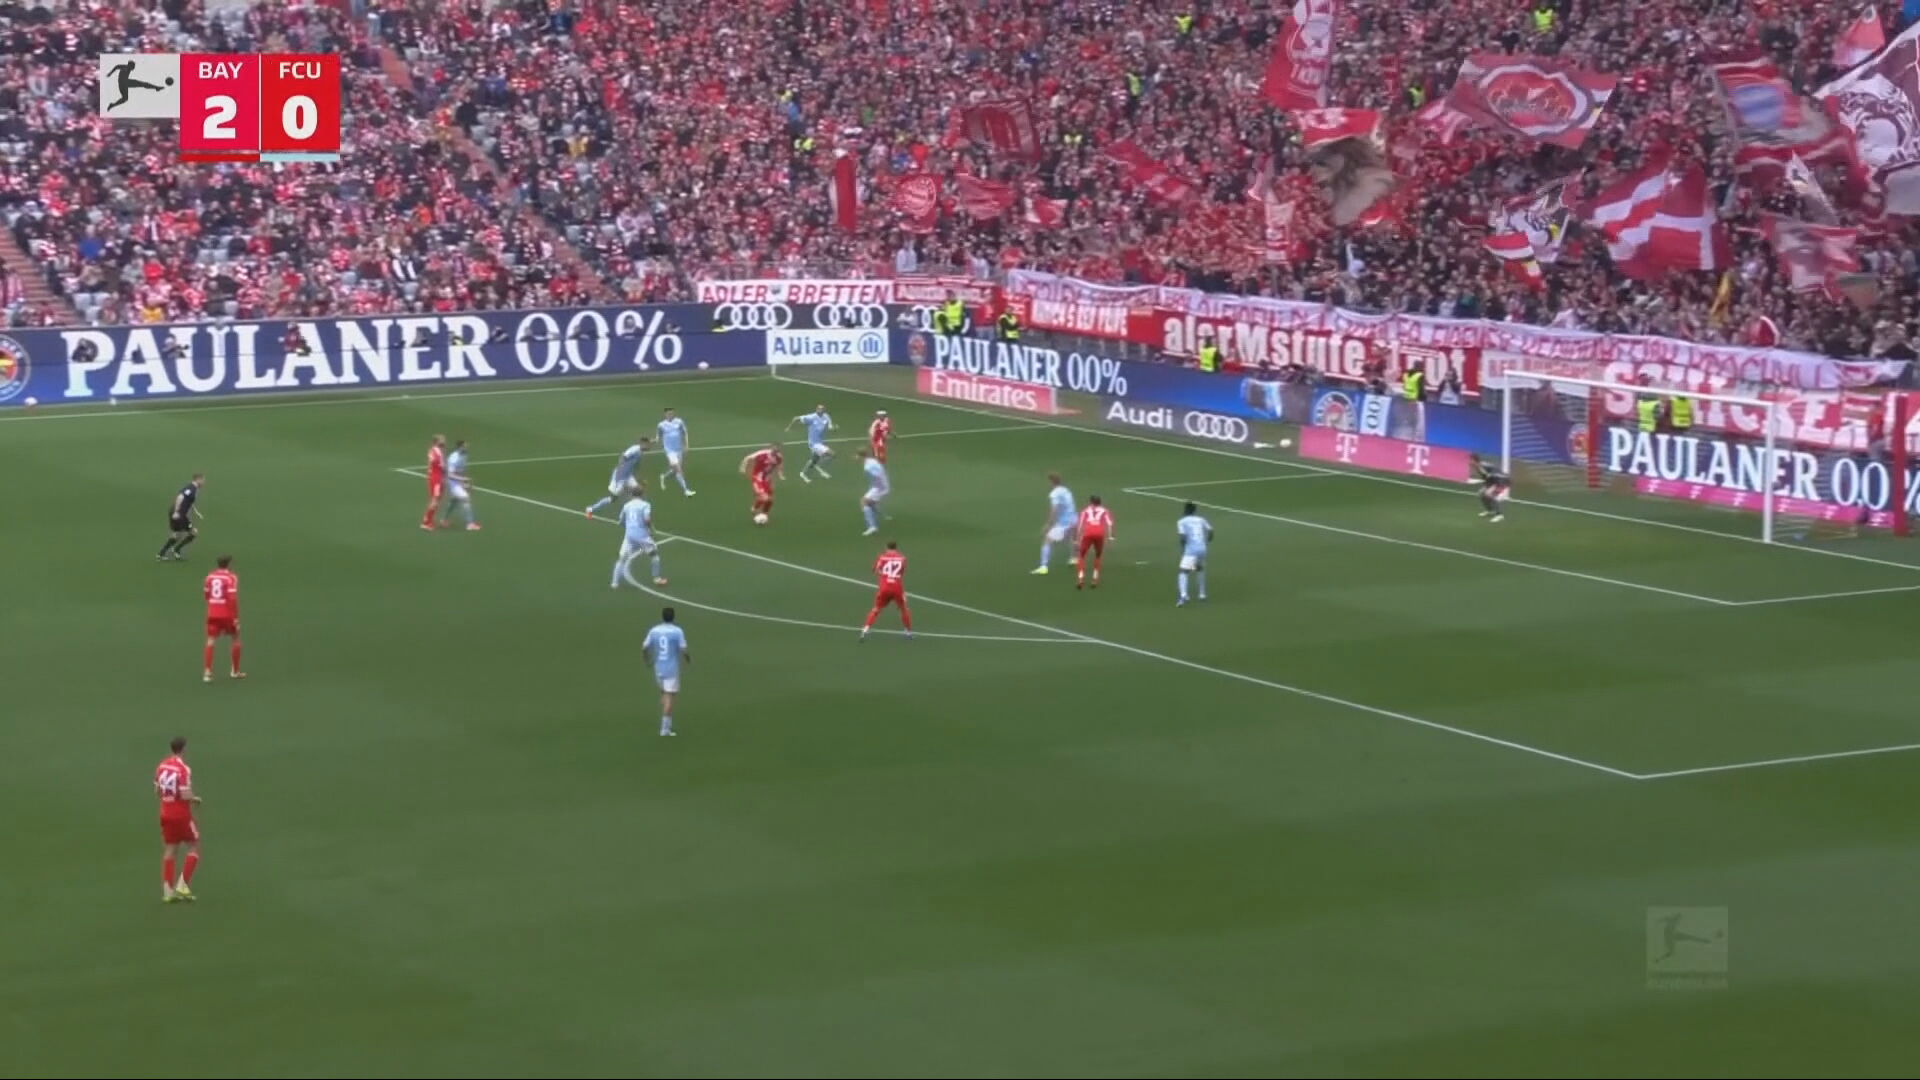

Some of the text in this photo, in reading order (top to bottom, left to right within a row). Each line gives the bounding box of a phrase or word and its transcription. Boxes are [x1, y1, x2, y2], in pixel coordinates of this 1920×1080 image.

[702, 285, 768, 303] ADLER
[788, 284, 889, 303] BRETTEN
[61, 315, 498, 398] PAULANER
[772, 336, 852, 357] Allianz
[933, 334, 1062, 388] PAULANER
[929, 371, 1038, 411] Emirates
[1106, 401, 1173, 430] Audi
[1608, 426, 1822, 501] PAULANER
[882, 560, 902, 578] 42
[210, 578, 222, 599] 8
[658, 636, 669, 655] 9
[158, 770, 178, 794] 44
